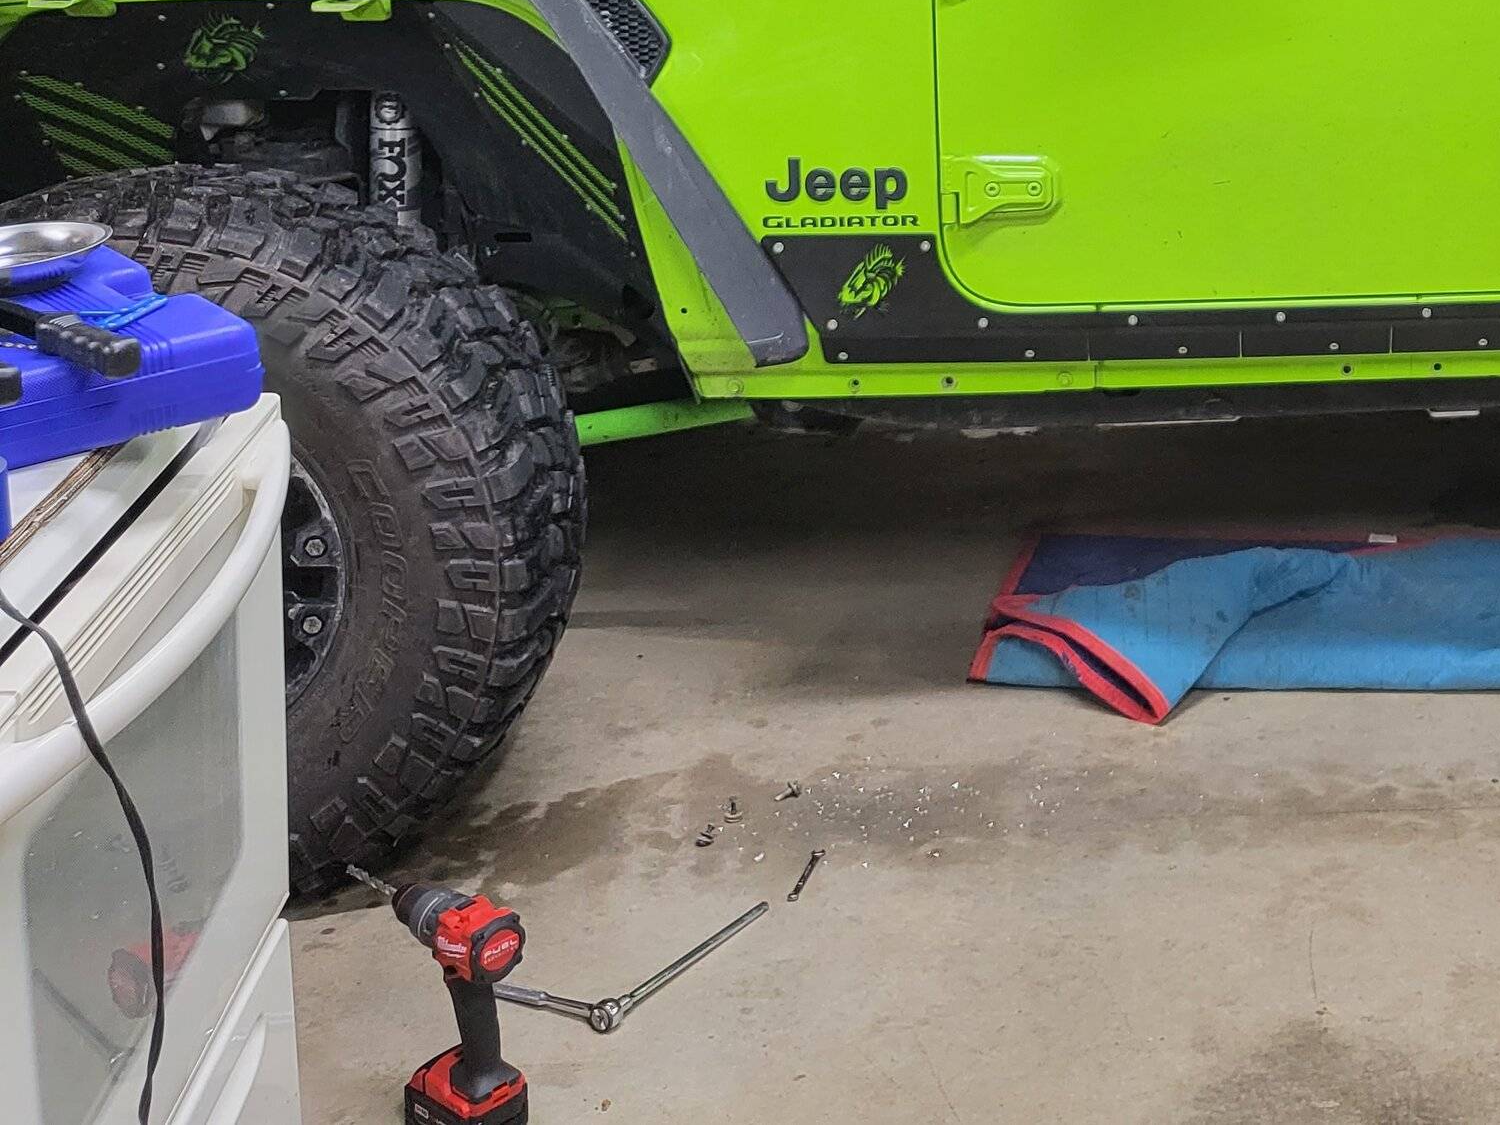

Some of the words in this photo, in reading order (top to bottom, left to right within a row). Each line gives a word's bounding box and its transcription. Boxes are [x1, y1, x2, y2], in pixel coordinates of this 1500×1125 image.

[376, 137, 407, 206] FOX
[765, 157, 908, 210] Jeep
[762, 215, 920, 229] GLADIATOR
